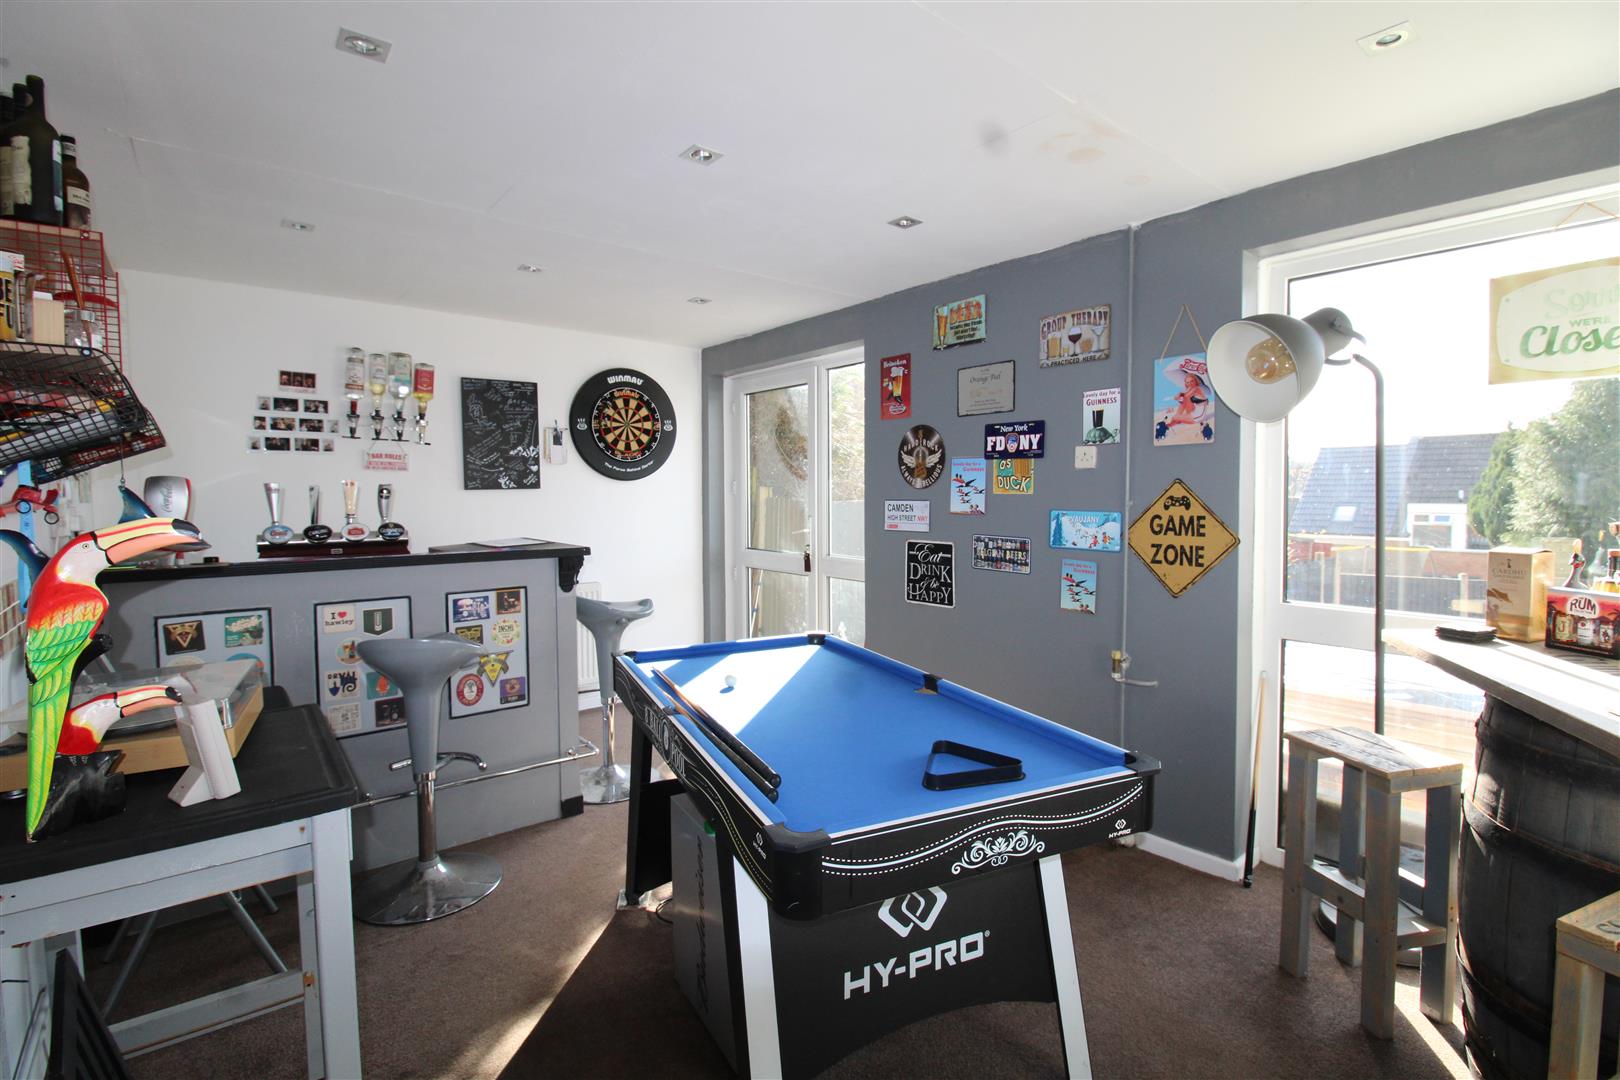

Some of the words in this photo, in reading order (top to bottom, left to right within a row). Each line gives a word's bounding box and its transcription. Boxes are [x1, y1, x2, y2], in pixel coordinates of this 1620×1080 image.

[1041, 316, 1067, 340] GROUP
[1071, 310, 1108, 326] THERAPY
[1520, 325, 1620, 358] Close
[1082, 354, 1097, 363] HERE
[1086, 396, 1118, 407] GUINNESS
[1014, 423, 1028, 432] York
[997, 476, 1031, 493] DUCK
[887, 503, 914, 512] CAMDEN
[1149, 514, 1206, 537] GAME
[914, 543, 942, 563] Eat
[1006, 550, 1027, 560] BEERS
[1150, 544, 1205, 567] ZONE
[909, 562, 952, 583] DRINK
[908, 583, 952, 604] HAPPY
[1569, 597, 1597, 615] RUM
[331, 612, 336, 620] I
[1108, 828, 1131, 839] HY-PRO
[844, 930, 984, 1001] HY-PRO
